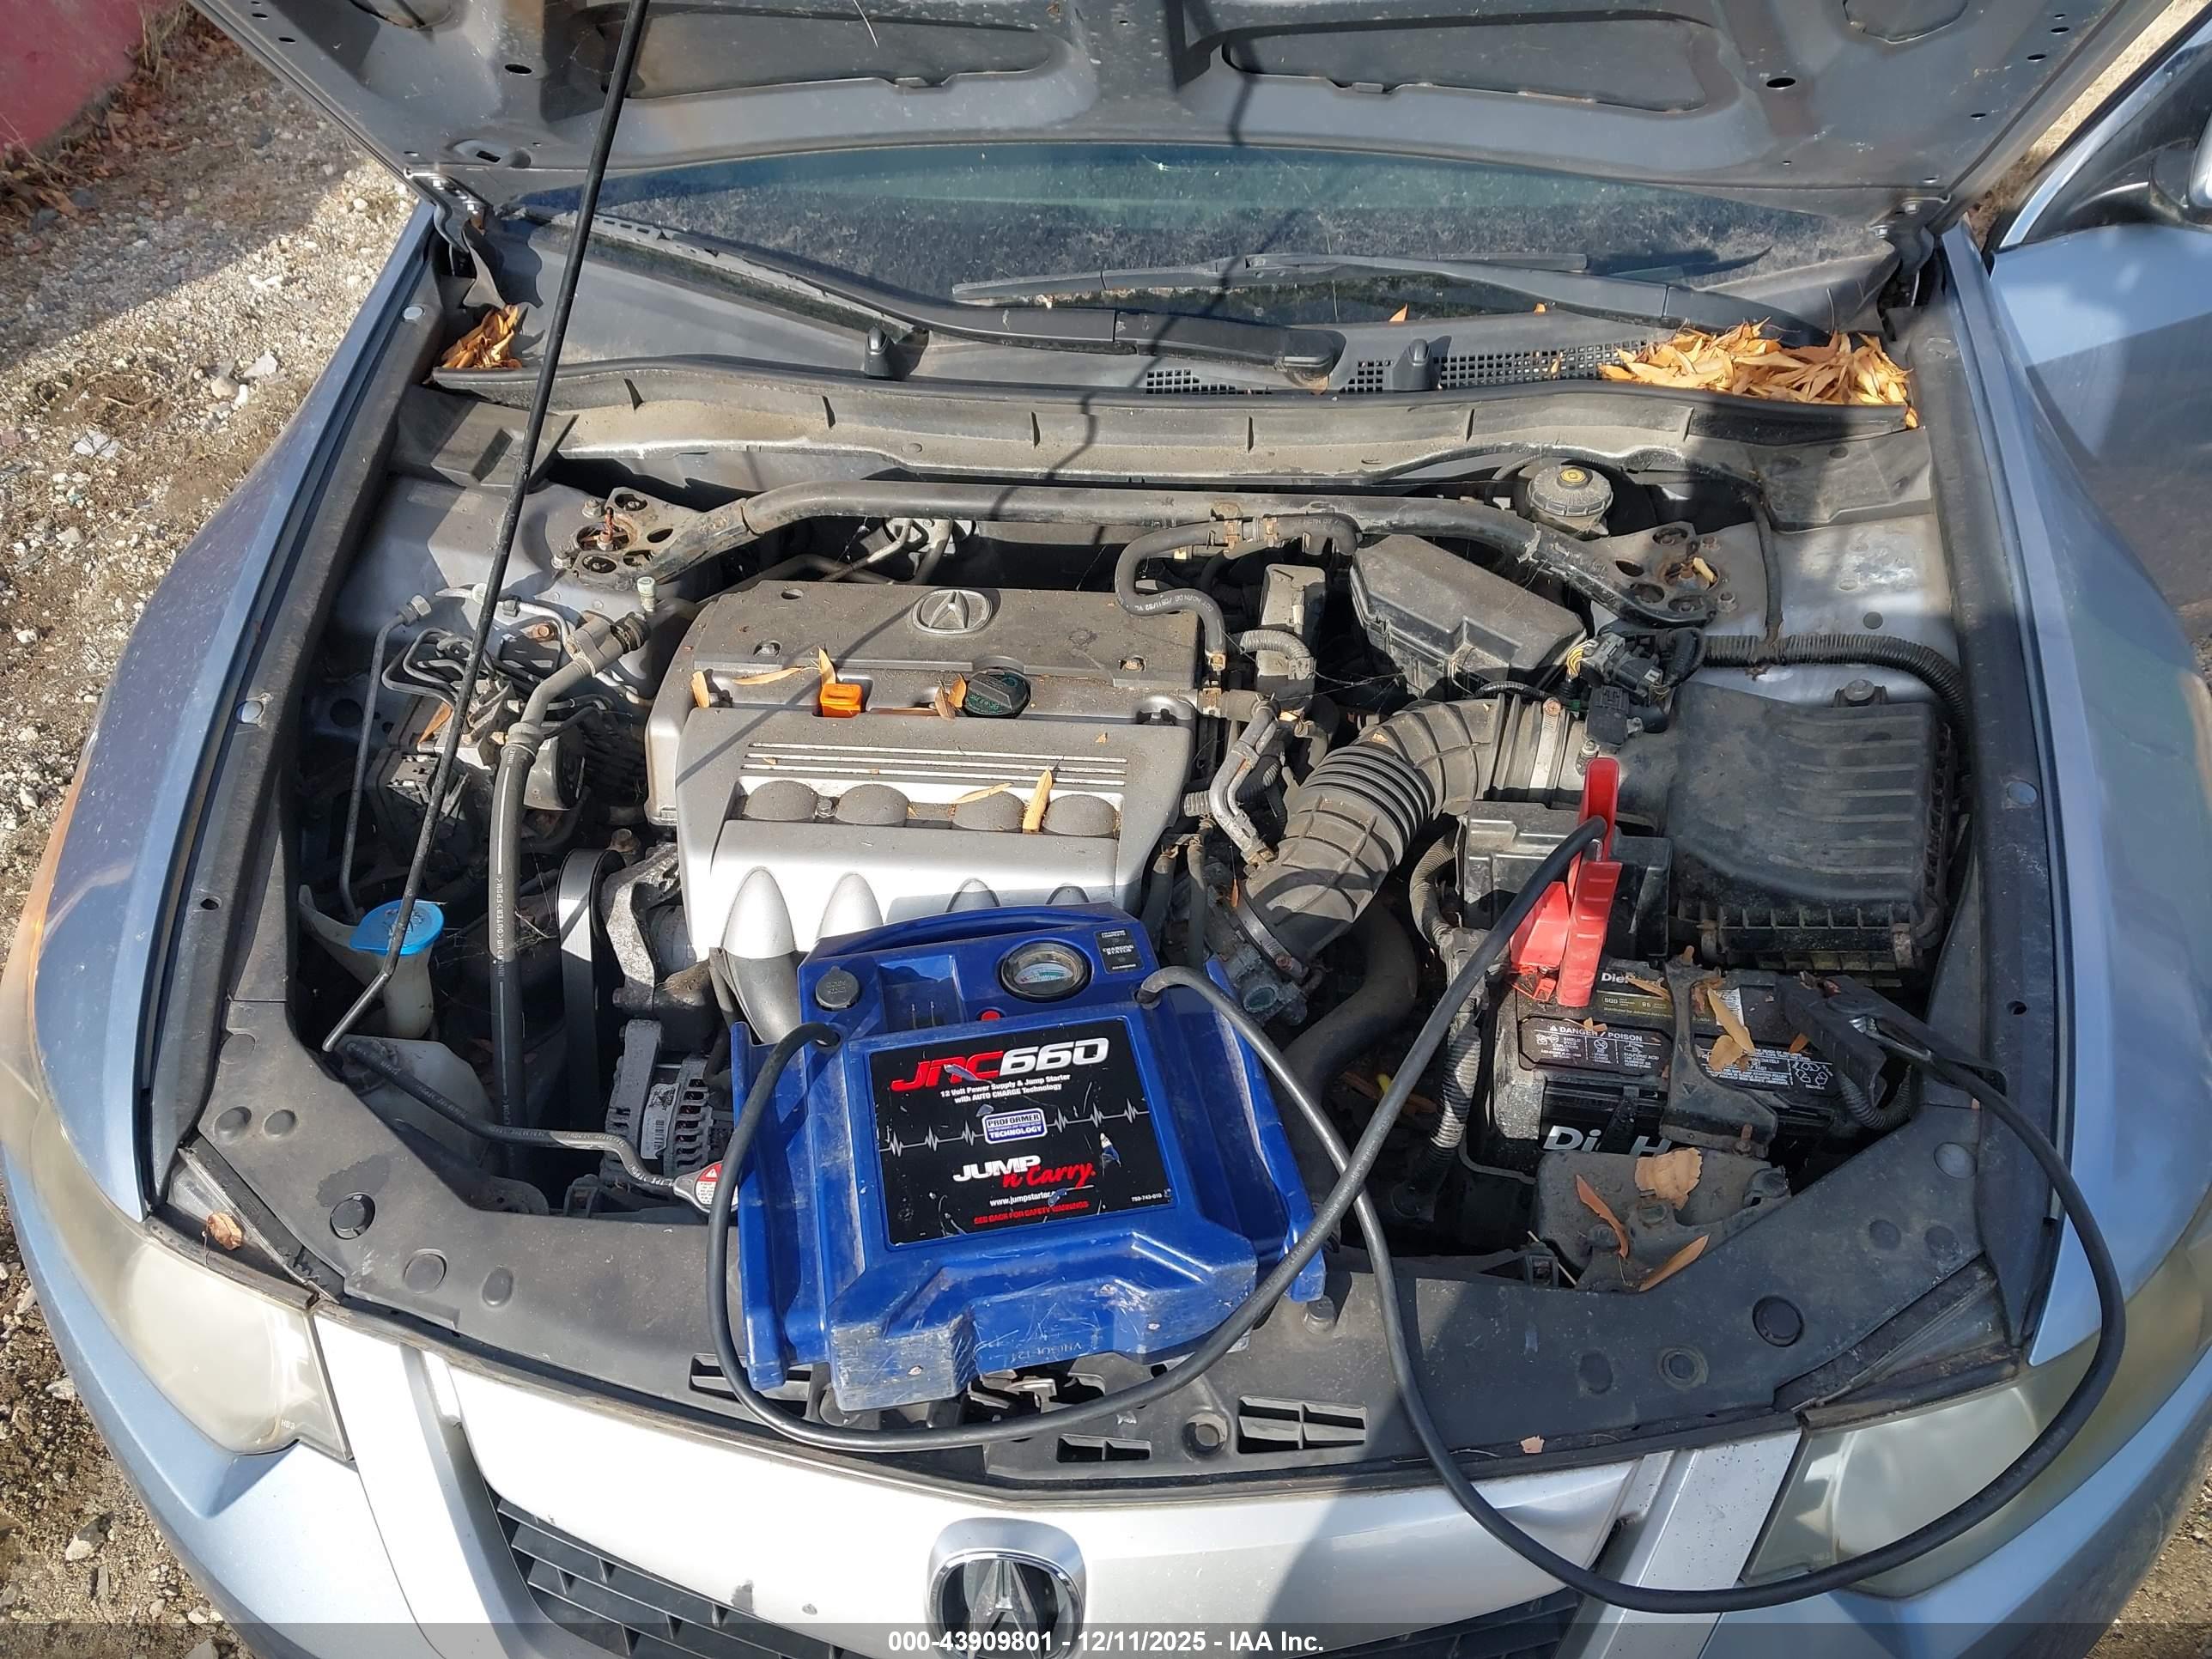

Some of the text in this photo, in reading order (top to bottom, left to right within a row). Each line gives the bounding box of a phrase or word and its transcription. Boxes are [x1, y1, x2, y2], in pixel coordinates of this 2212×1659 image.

[1559, 1026, 1598, 1037] DANGER
[1607, 1032, 1644, 1042] POISON
[940, 1090, 951, 1098] 12
[951, 1087, 966, 1097] Volt
[966, 1085, 990, 1095] Power
[990, 1081, 1017, 1091] Supply
[1024, 1077, 1045, 1086] Jump
[1045, 1073, 1071, 1083] Starter
[954, 1083, 1062, 1103] with AUTO CHARGE Technology
[988, 1114, 1040, 1127] PROFORMER
[989, 1125, 1042, 1139] TECHNOLOGY
[952, 1155, 1042, 1182] JUMP
[1026, 1163, 1093, 1189] Carry
[974, 1200, 1090, 1224] SEE BACK FOR SAFETY WARNINGS
